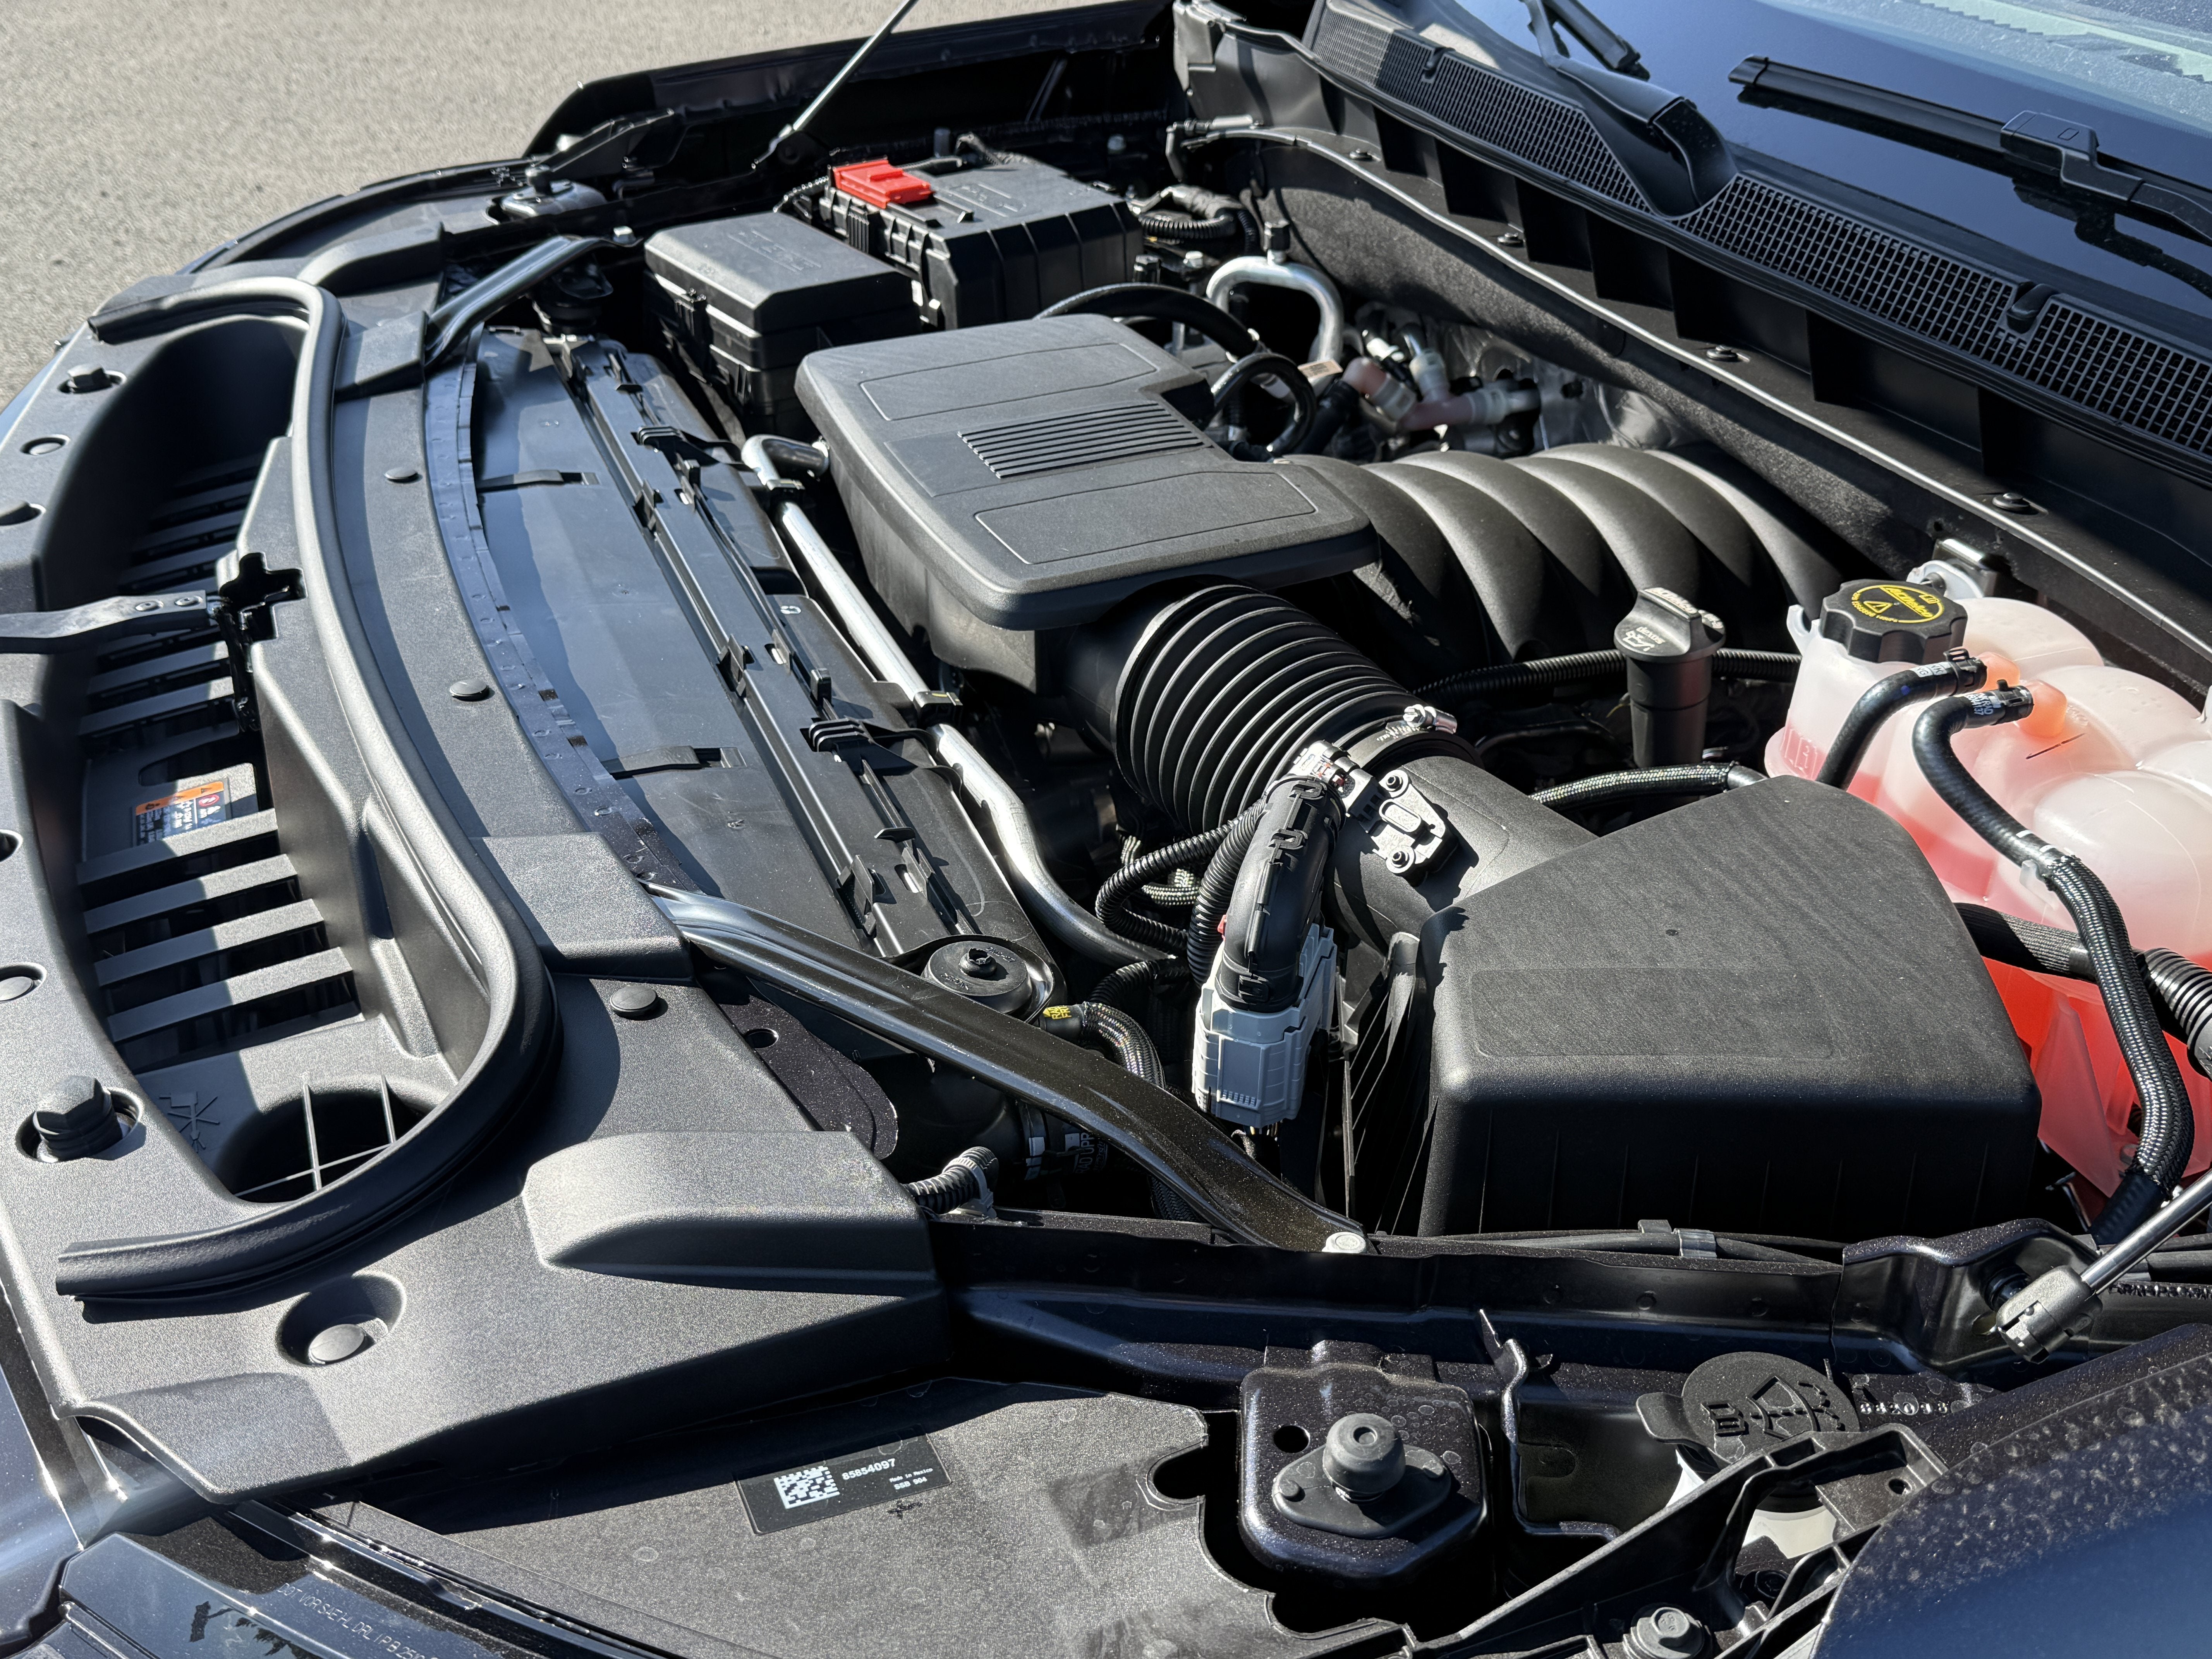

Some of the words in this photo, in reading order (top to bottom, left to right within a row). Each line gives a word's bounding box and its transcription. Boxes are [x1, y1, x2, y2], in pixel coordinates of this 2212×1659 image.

[1636, 626, 1666, 644] dexos
[1047, 1006, 1062, 1020] RAD
[842, 1458, 896, 1480] 85854097
